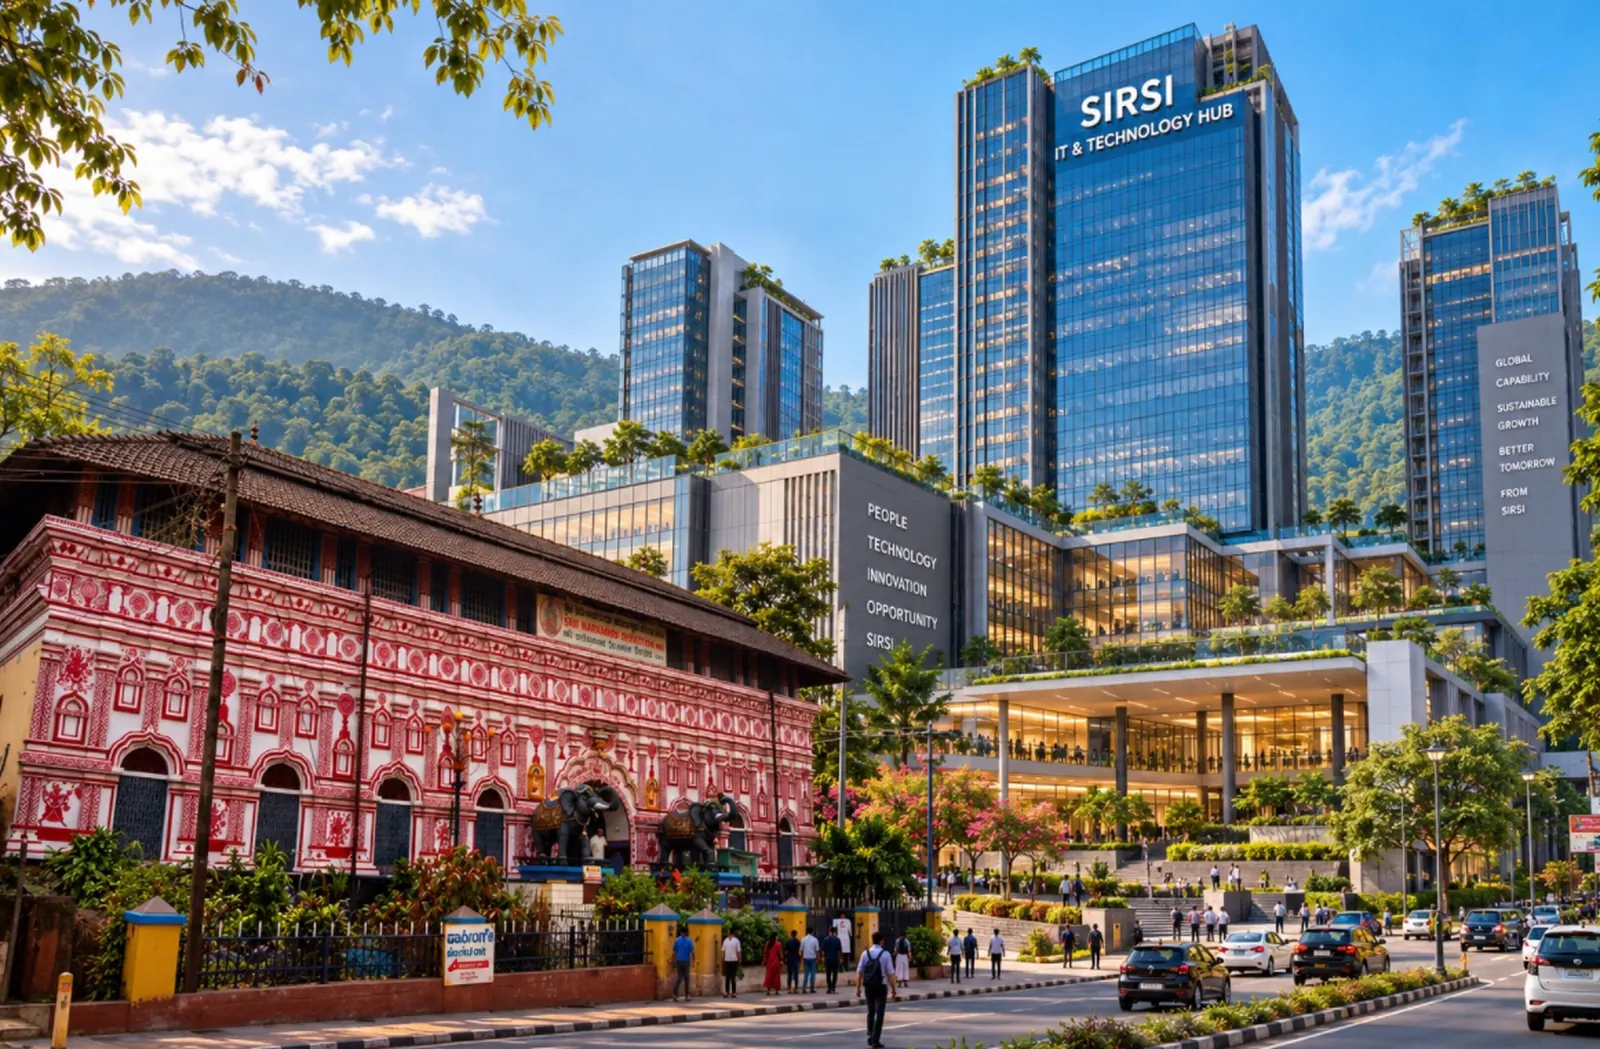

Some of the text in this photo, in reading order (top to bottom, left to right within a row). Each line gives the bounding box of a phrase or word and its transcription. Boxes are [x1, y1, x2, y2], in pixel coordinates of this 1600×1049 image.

[1080, 74, 1173, 128] SIRSI
[1055, 103, 1233, 160] IT & TECHNOLOGY HUB
[1495, 354, 1533, 368] GLOBAL
[1496, 372, 1550, 388] CAPABILITY
[1497, 396, 1557, 413] SUSTAINABLE
[1498, 416, 1539, 430] GROWTH
[1499, 443, 1534, 456] BETTER
[1500, 457, 1555, 472] TOMORROW
[1500, 487, 1528, 498] FROM
[868, 503, 908, 529] PEOPLE
[1502, 504, 1525, 516] SIRSI
[867, 535, 937, 570] TECHNOLOGY
[867, 568, 927, 597] INNOVATION
[867, 600, 938, 630] OPPORTUNITY
[866, 632, 894, 650] SIRSI
